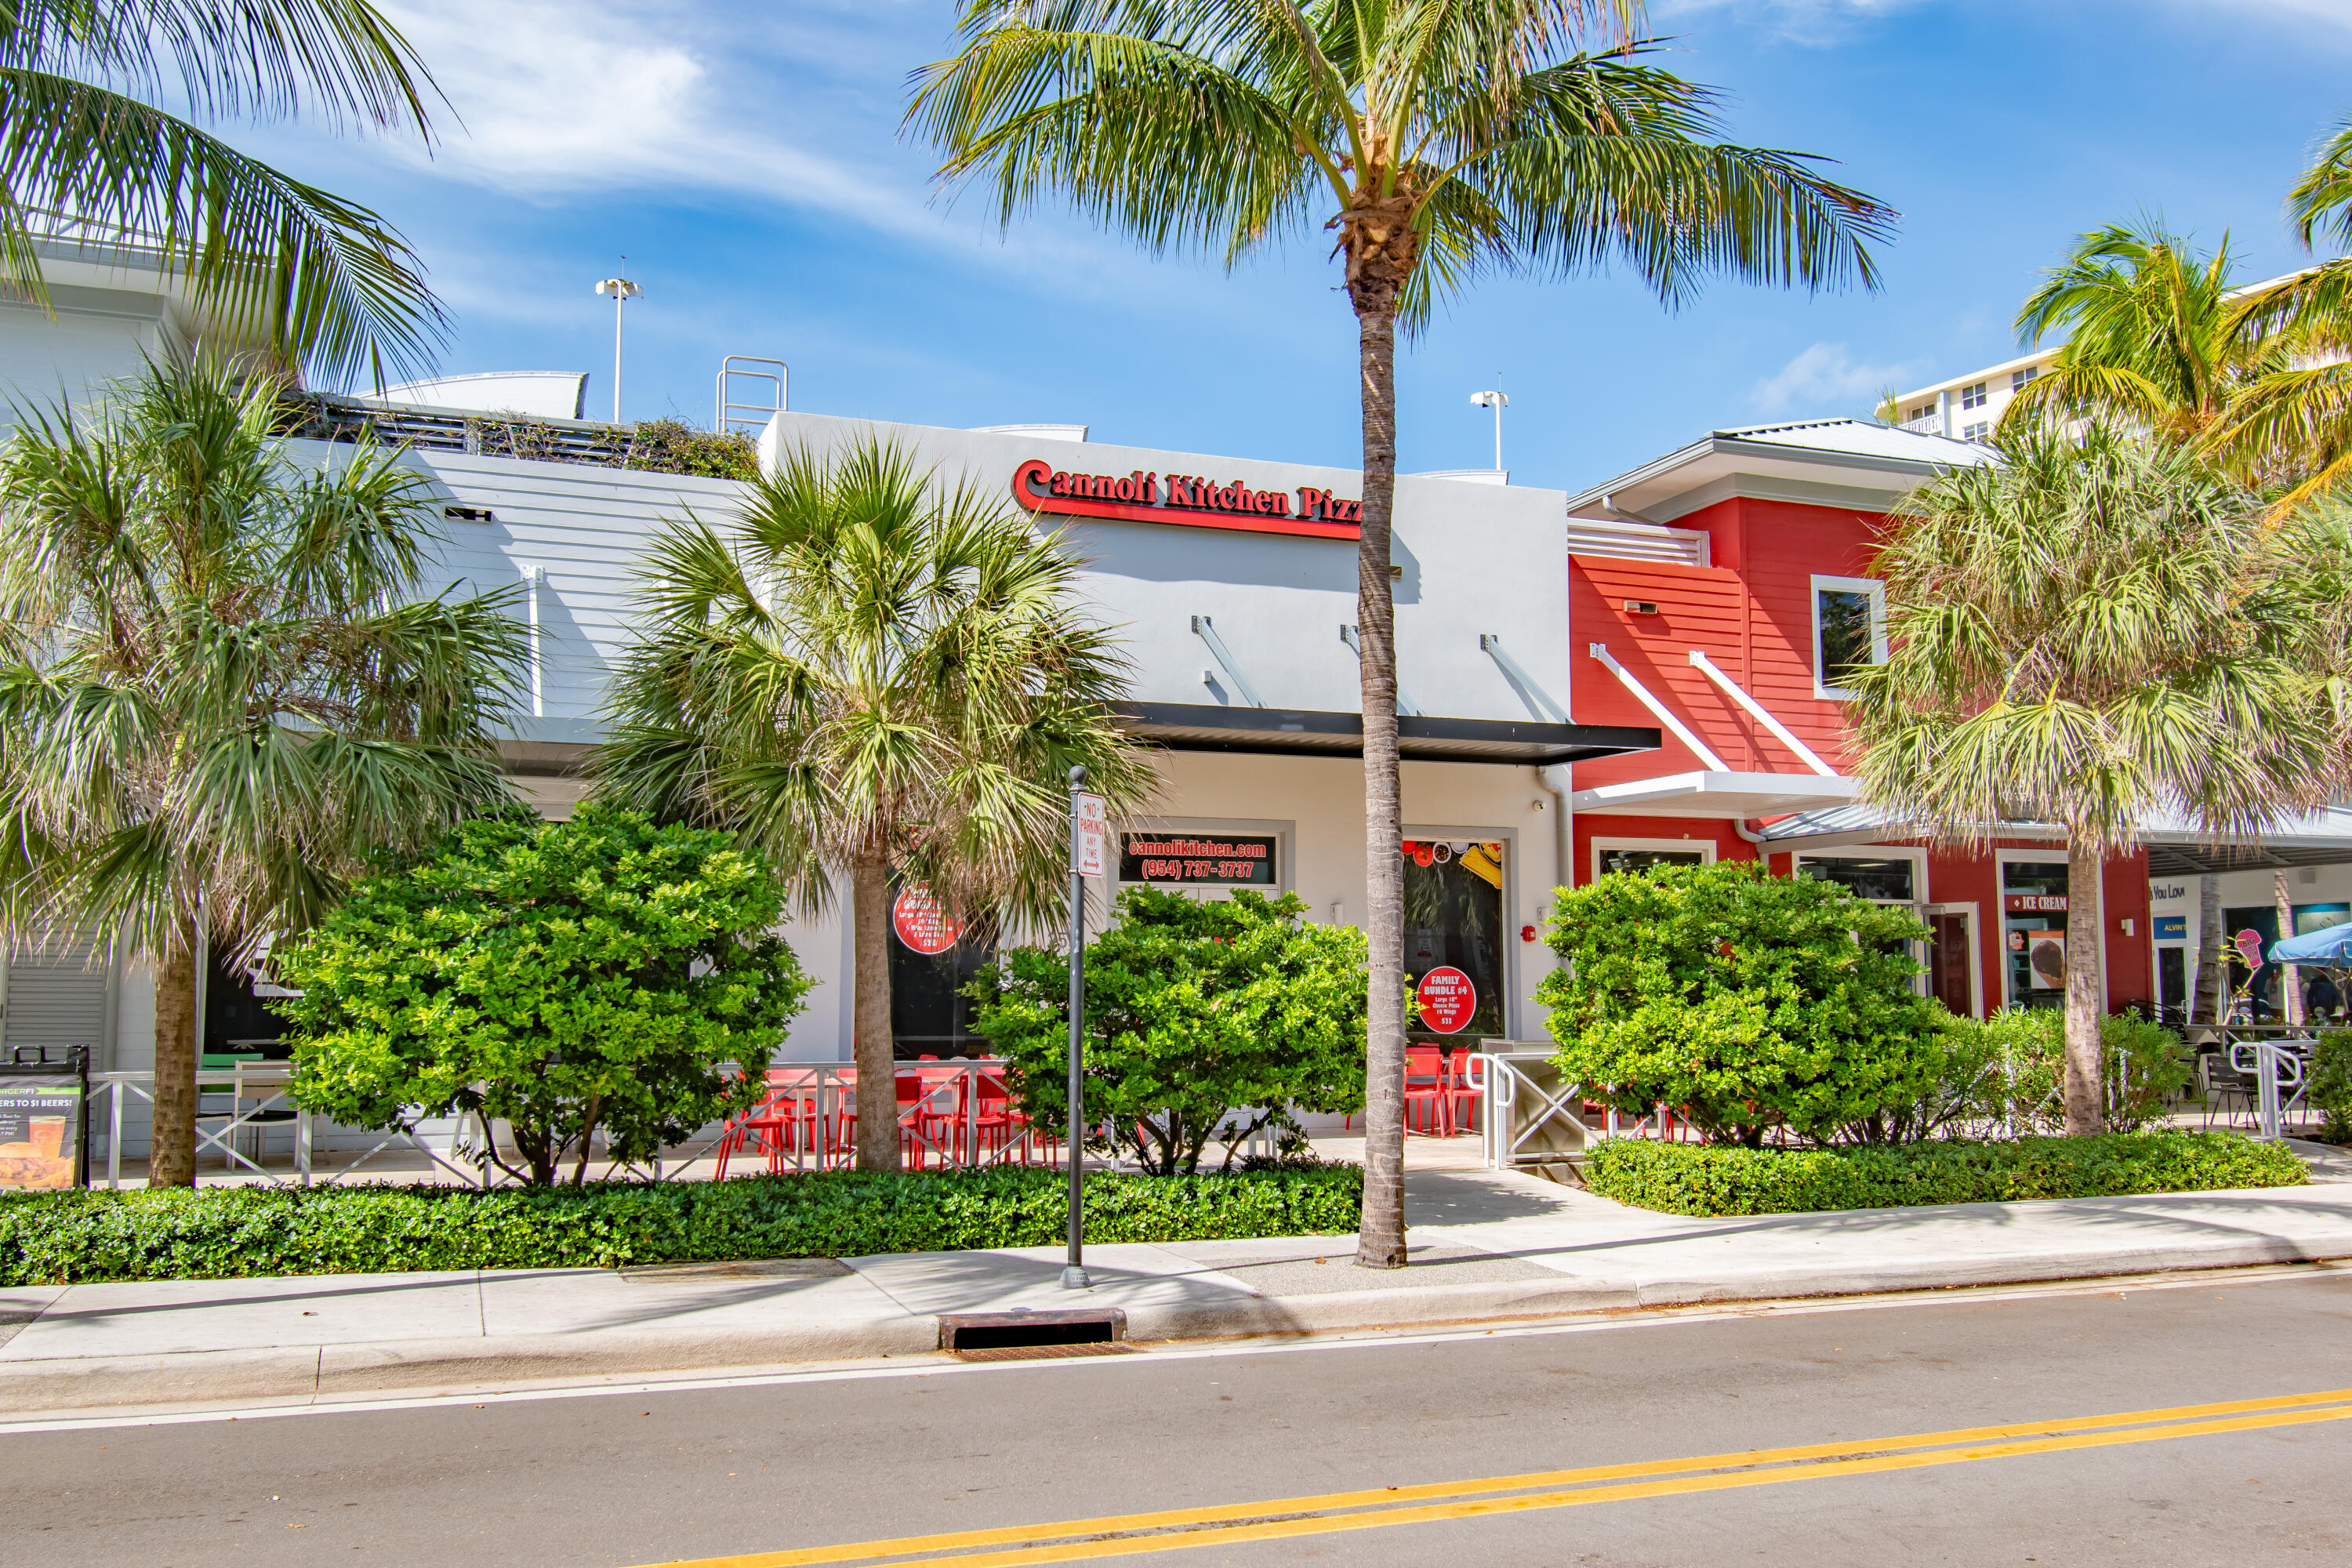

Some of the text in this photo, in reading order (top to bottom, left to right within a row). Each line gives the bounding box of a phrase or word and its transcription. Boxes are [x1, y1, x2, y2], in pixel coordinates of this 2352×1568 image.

[1011, 459, 1157, 511] Cannoli
[1164, 474, 1290, 515] Kitchen
[1087, 802, 1097, 818] NO
[1080, 818, 1102, 836] PARKING
[1087, 836, 1096, 846] ANY
[1086, 848, 1097, 859] TIME
[1129, 840, 1266, 858] cannolikitchen.com
[1142, 859, 1254, 880] (954) 737-3737
[2153, 885, 2167, 900] You
[2022, 896, 2067, 910] ICE CREAM
[1431, 976, 1460, 985] FAMILY
[1424, 986, 1467, 995] BUNDLE #4
